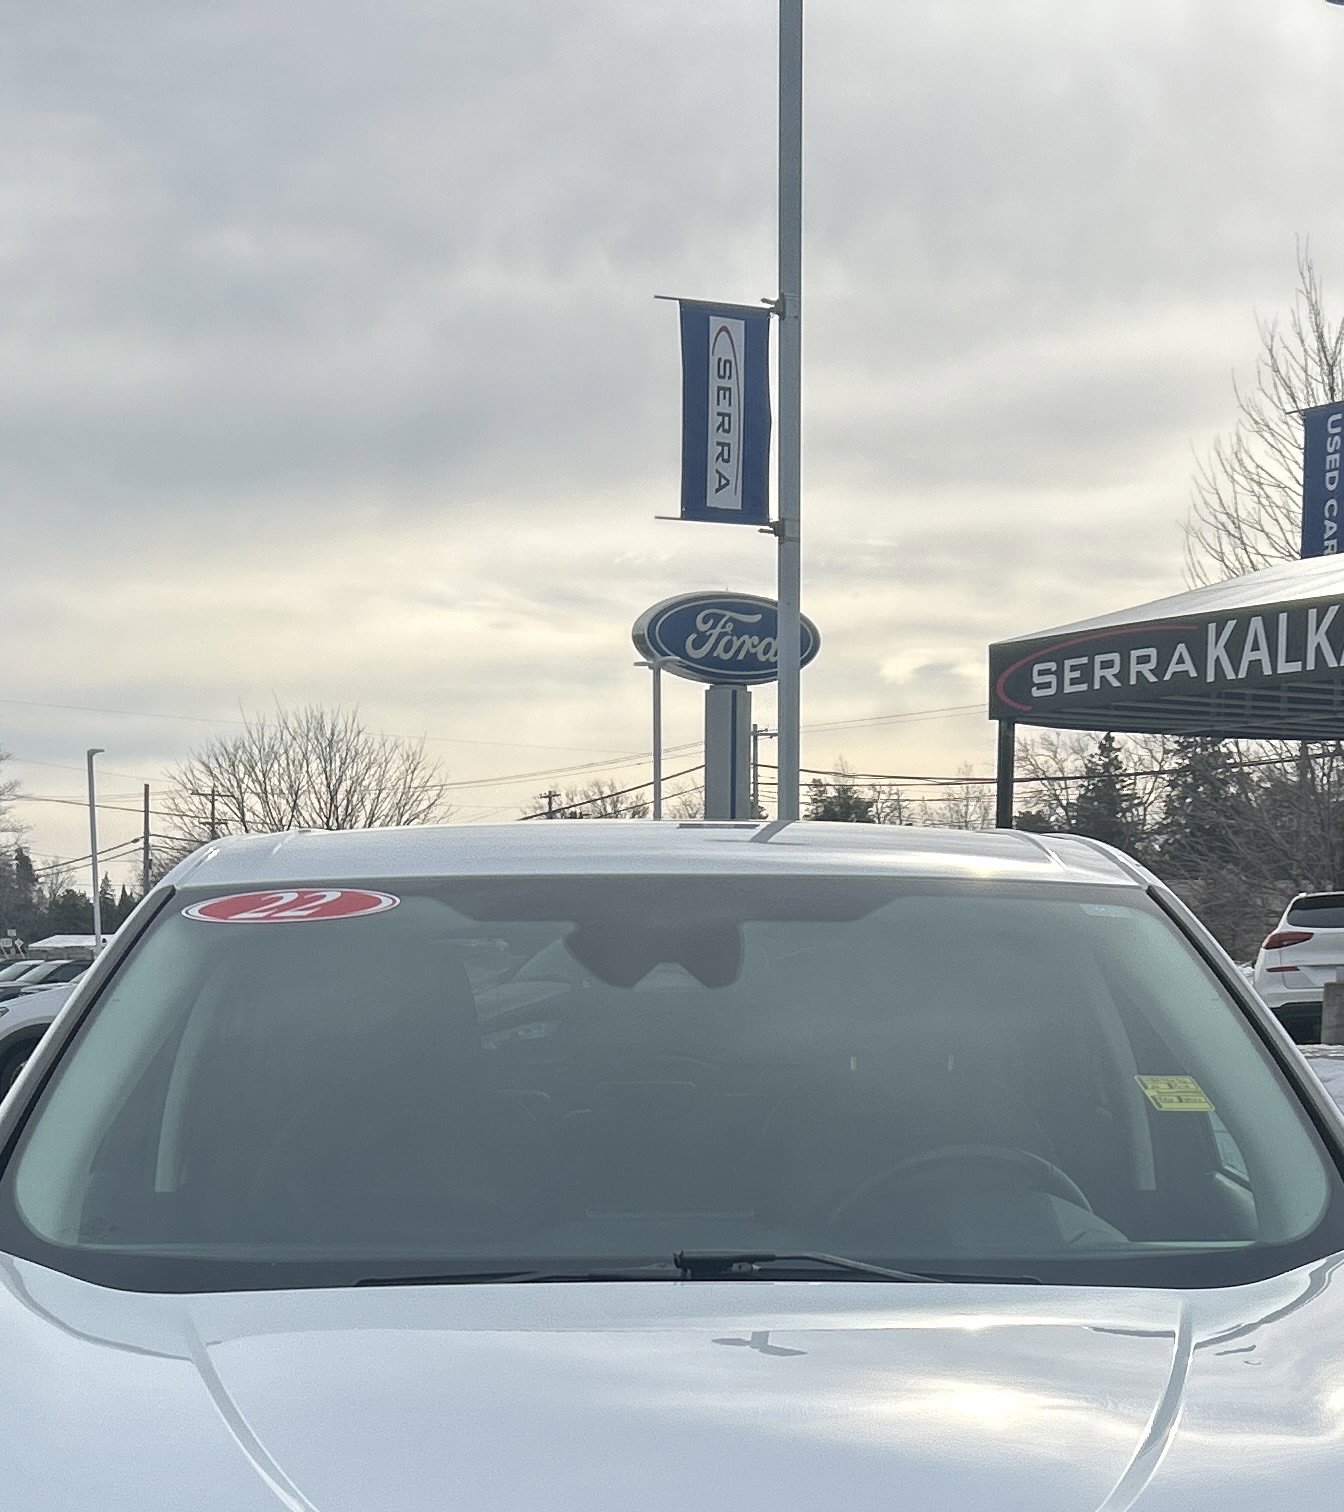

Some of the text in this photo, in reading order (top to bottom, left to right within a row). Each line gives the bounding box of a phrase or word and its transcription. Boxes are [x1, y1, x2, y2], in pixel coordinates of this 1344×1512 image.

[714, 356, 733, 496] SERRA
[1323, 413, 1343, 555] USED CAR
[684, 608, 779, 663] Ford
[1030, 643, 1199, 697] SERRA
[227, 890, 343, 919] 22
